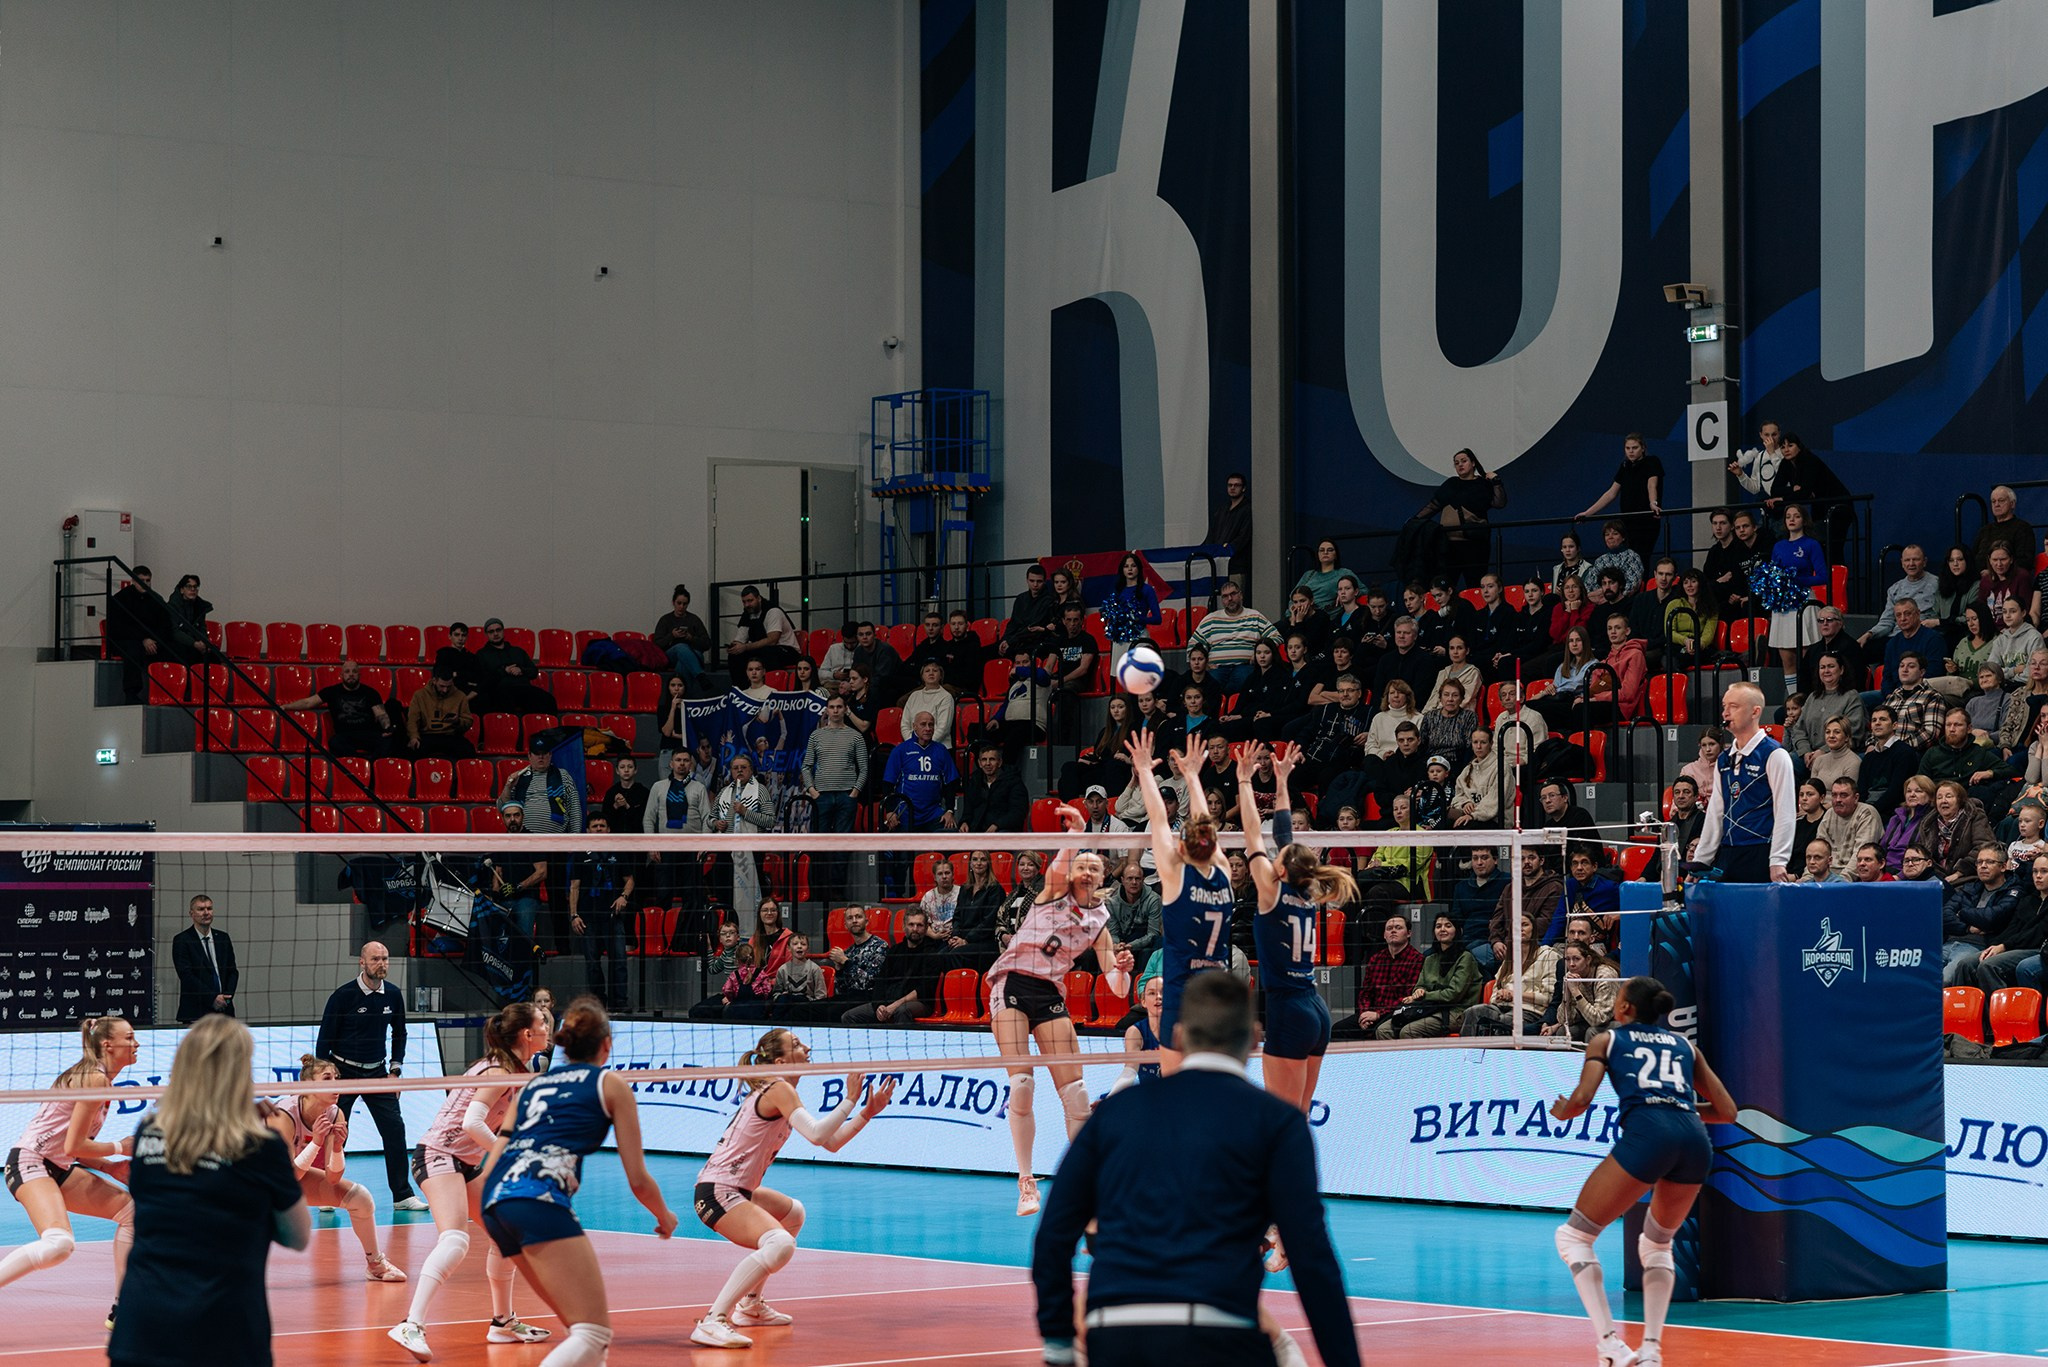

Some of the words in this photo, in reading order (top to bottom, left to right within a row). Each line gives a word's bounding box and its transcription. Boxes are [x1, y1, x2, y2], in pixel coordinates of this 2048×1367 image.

[1695, 412, 1719, 451] C
[918, 756, 932, 772] 16
[53, 859, 105, 871] ЧЕМПИОНАТ
[106, 859, 142, 871] РОССИИ
[57, 911, 78, 921] ВФВ
[1205, 911, 1223, 956] 7
[1288, 915, 1316, 963] 14
[1805, 952, 1851, 966] КОРАБЕЛКА
[1889, 948, 1922, 967] ВФВ
[1629, 1031, 1677, 1046] МОРЕНО
[1634, 1047, 1685, 1093] 24
[519, 1087, 558, 1131] 5
